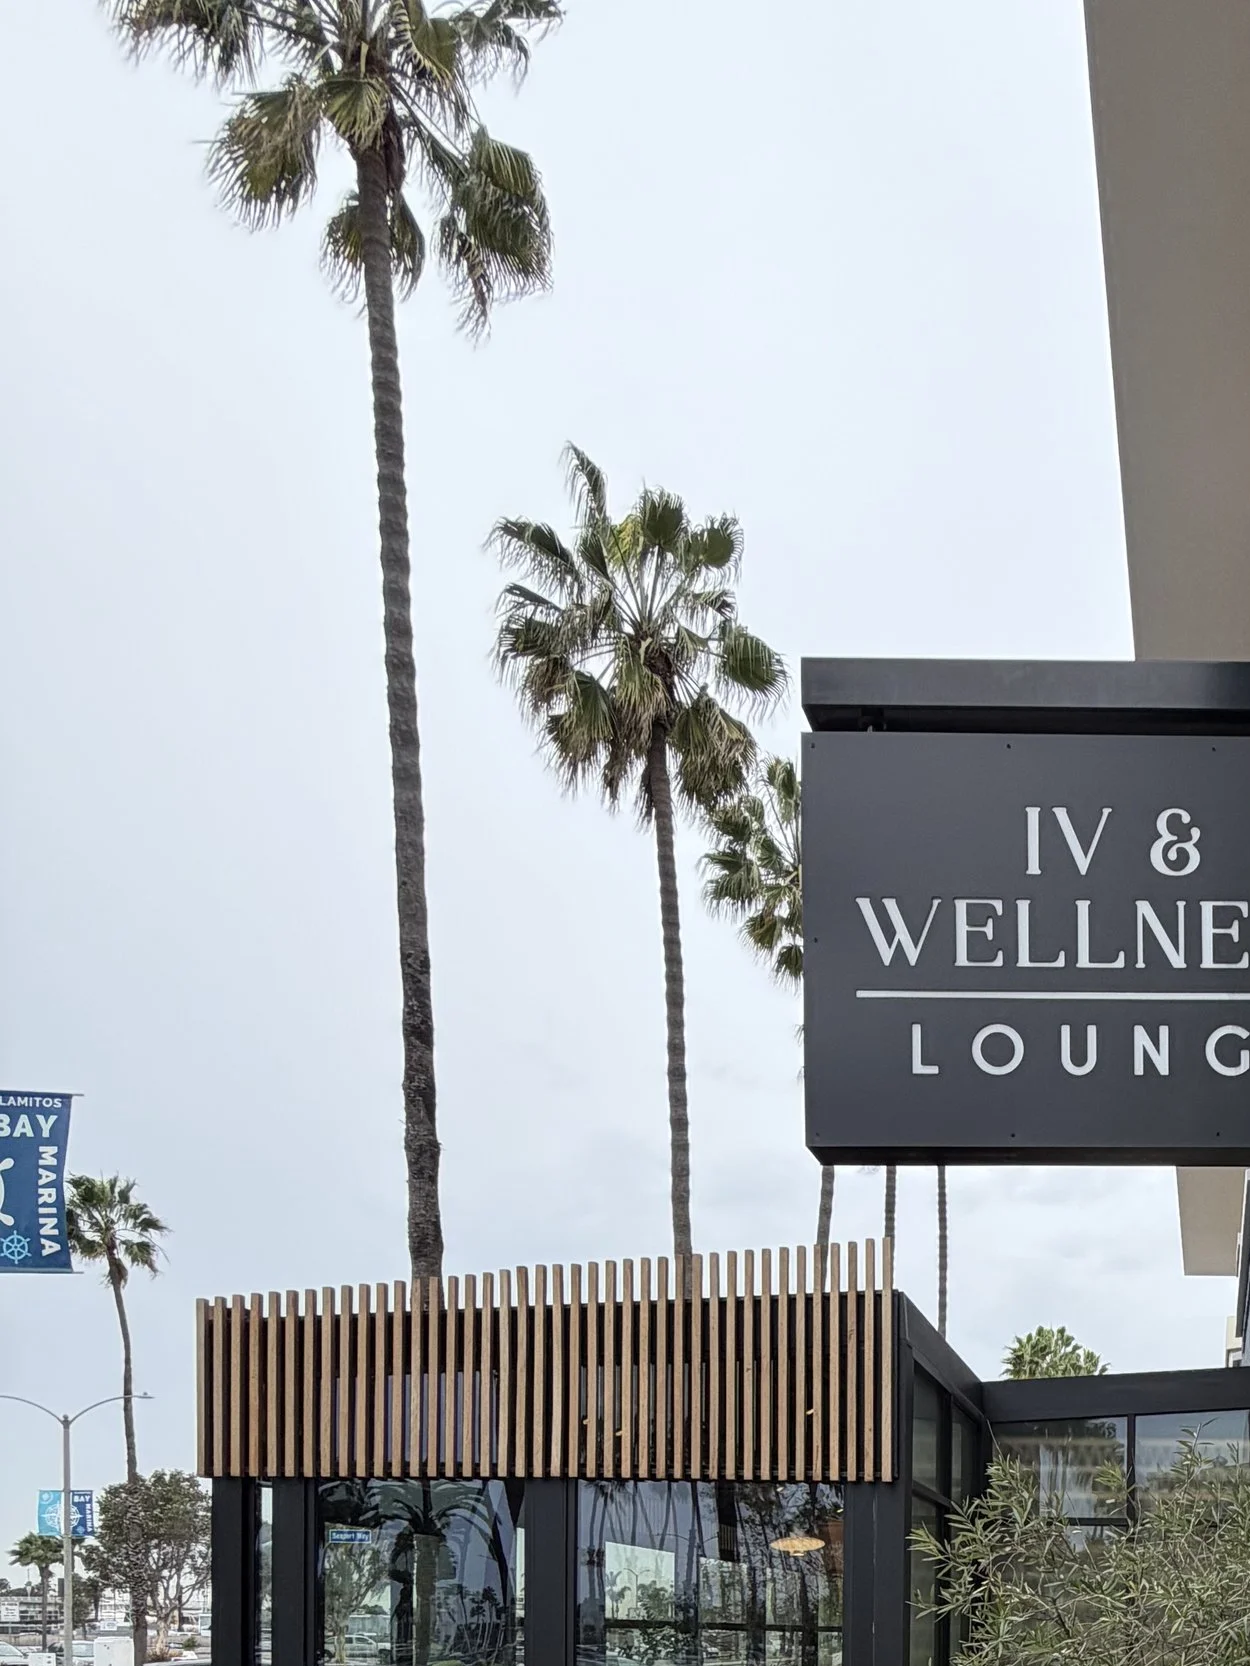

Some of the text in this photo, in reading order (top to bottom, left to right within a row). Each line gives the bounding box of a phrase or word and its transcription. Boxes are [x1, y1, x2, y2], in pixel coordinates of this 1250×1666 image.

[1025, 806, 1201, 877] IV &
[0, 1113, 58, 1138] BAY
[37, 1145, 61, 1257] MARINA
[85, 1503, 93, 1533] MARINA
